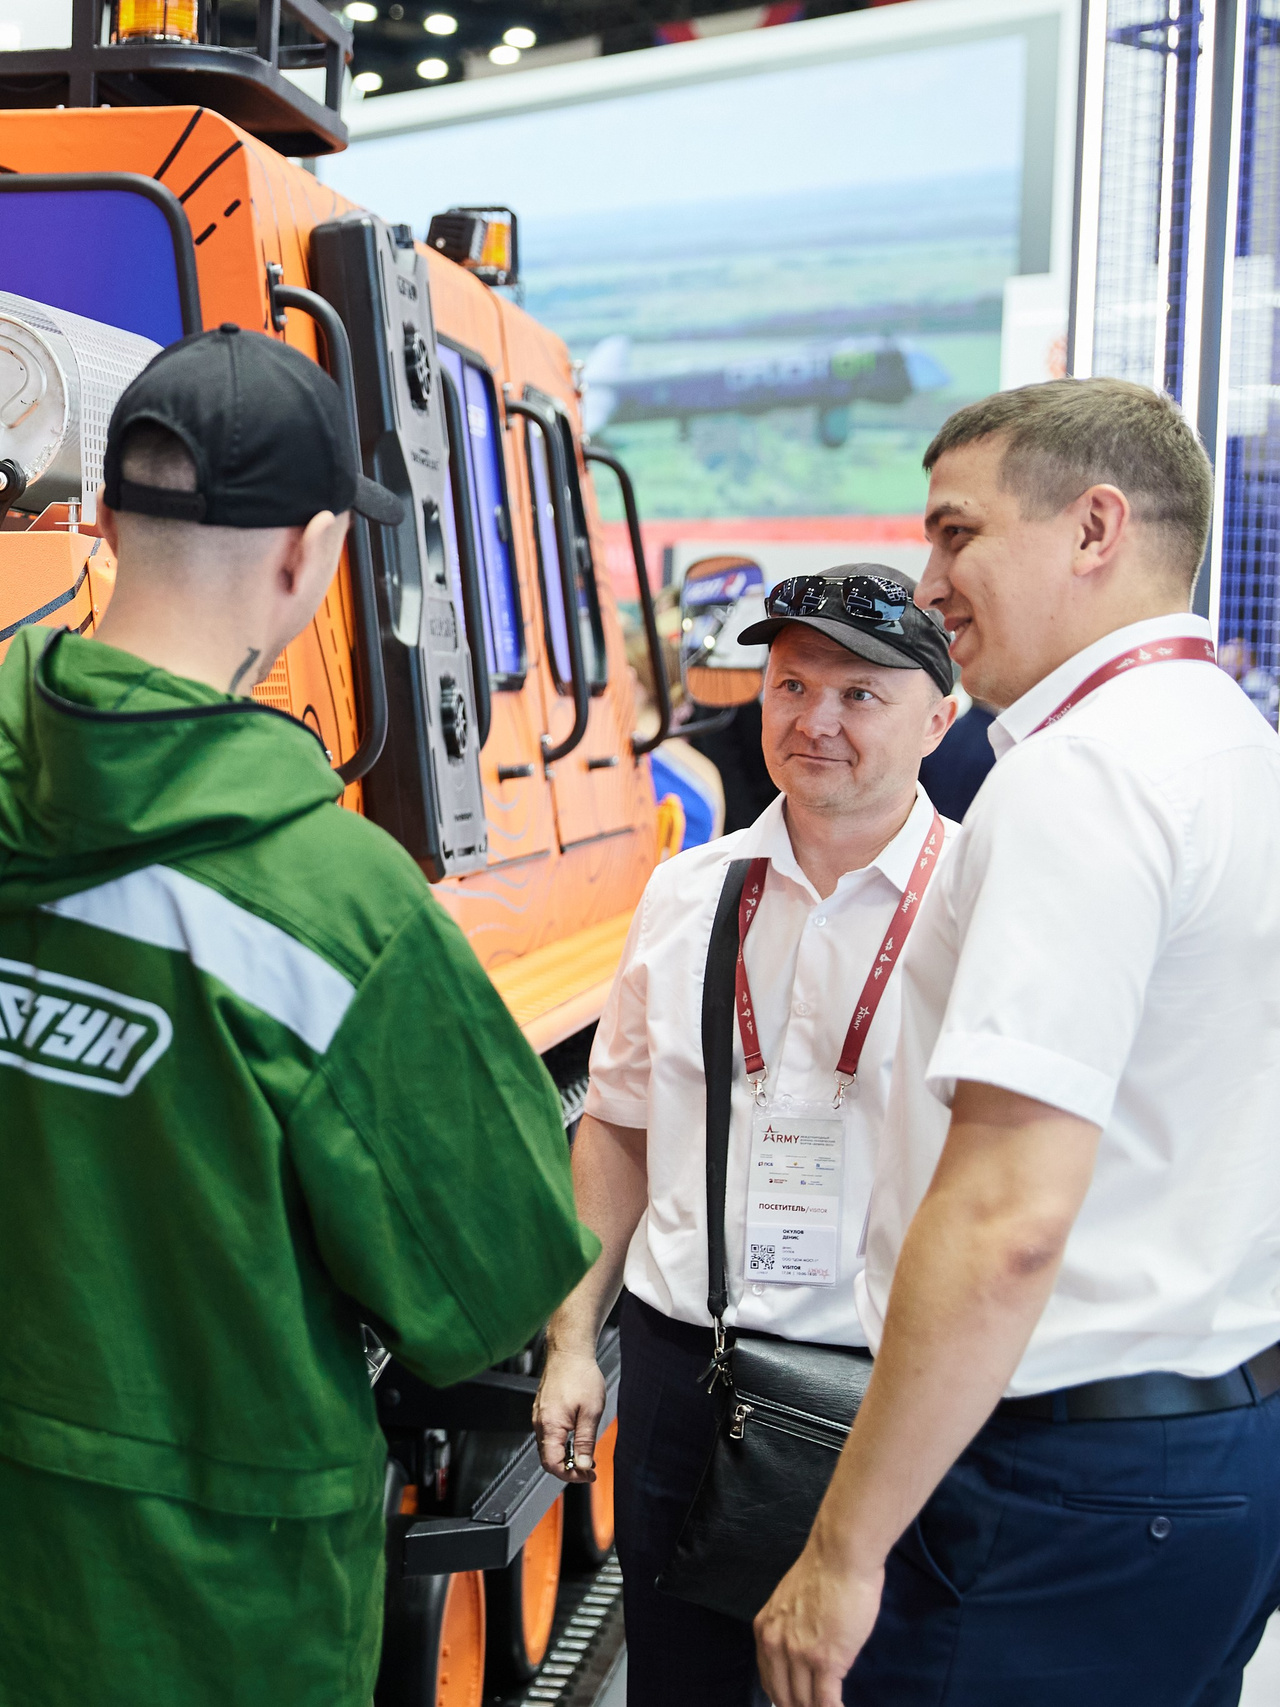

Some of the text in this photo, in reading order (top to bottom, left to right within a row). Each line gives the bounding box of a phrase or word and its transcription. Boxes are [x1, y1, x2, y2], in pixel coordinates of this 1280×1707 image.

[901, 890, 918, 914] ARMY
[853, 1006, 870, 1031] ARMY
[762, 1124, 800, 1144] ARMY
